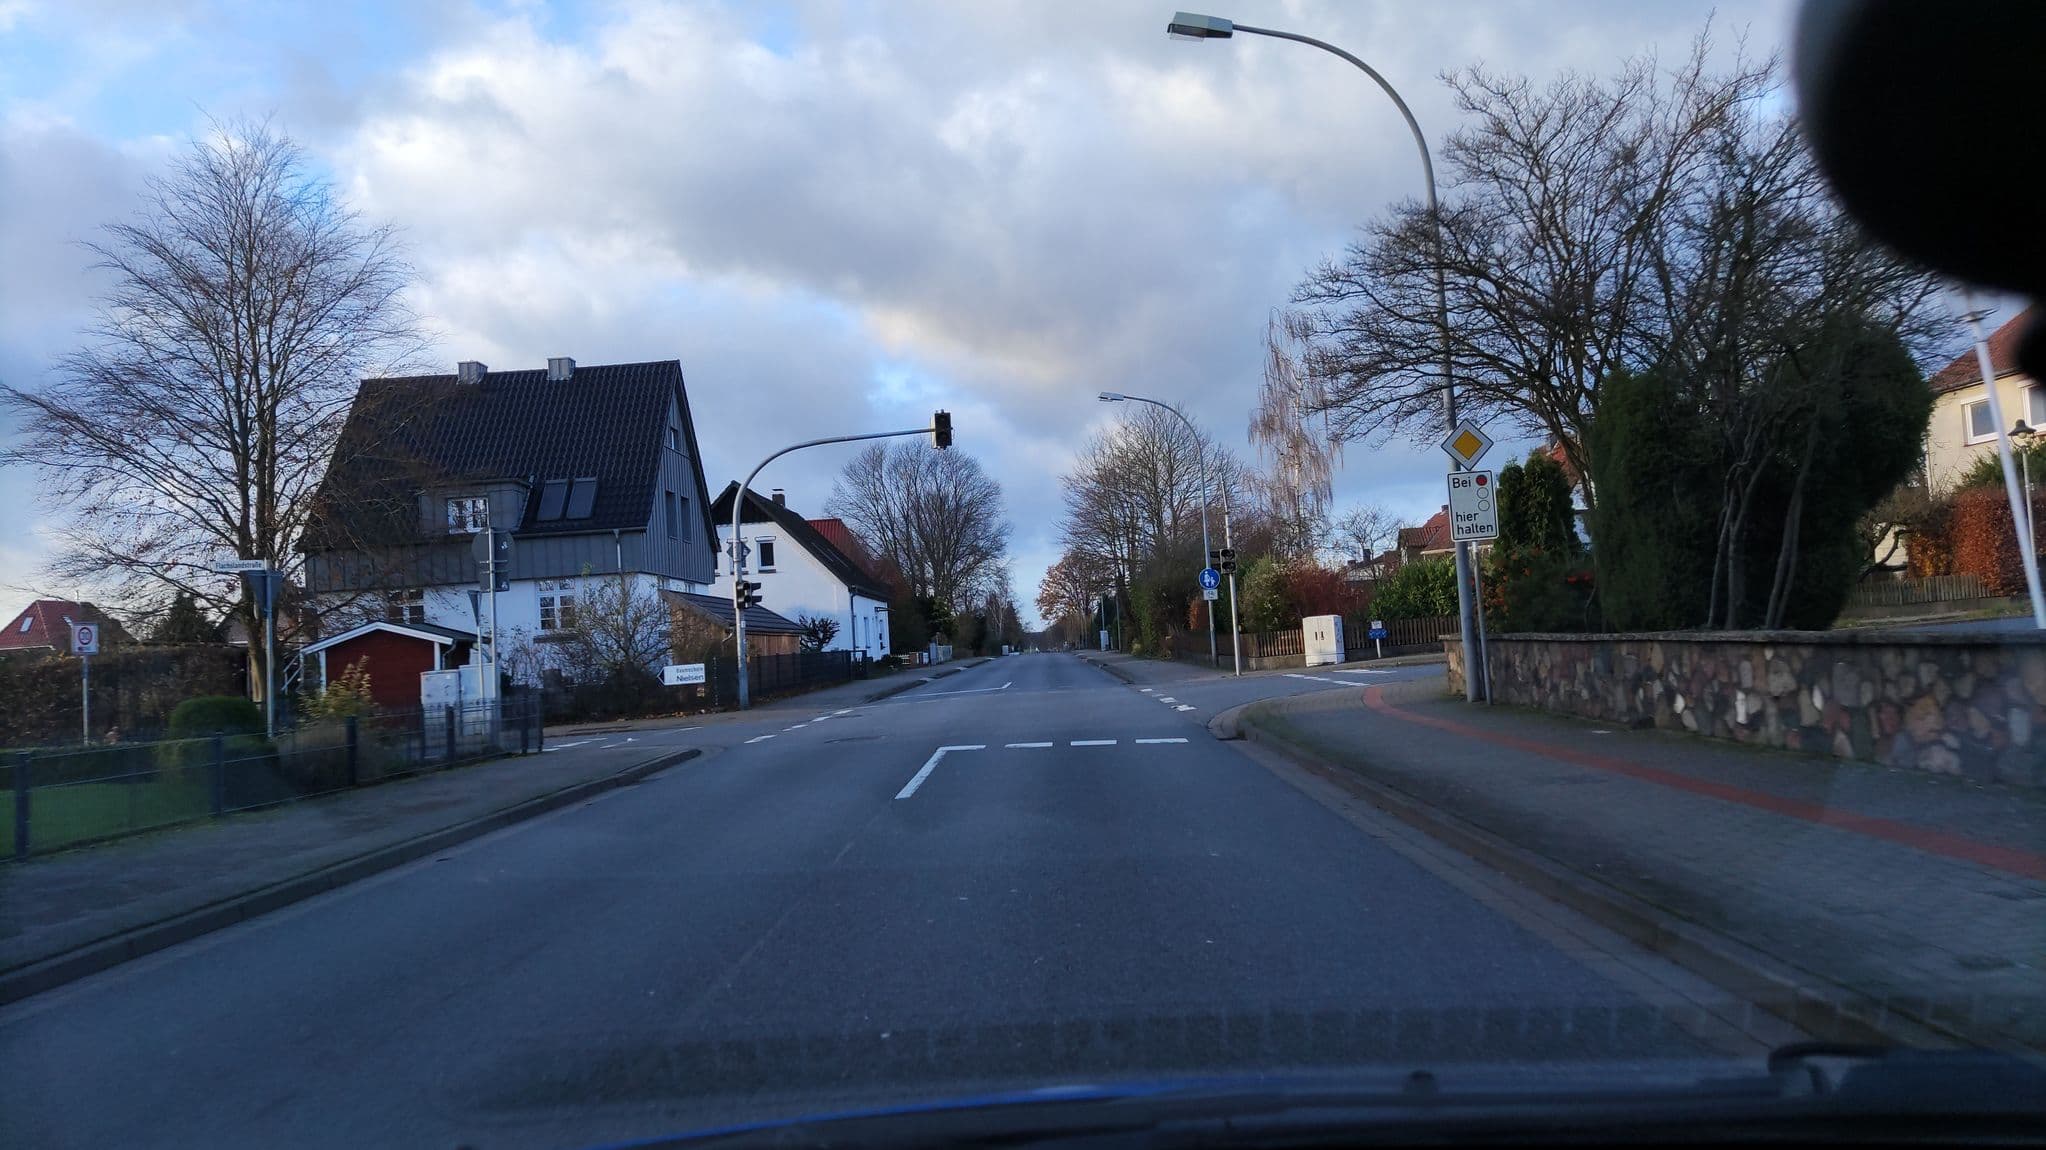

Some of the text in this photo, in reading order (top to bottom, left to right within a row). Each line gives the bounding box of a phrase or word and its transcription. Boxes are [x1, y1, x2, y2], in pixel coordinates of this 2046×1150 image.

[1452, 477, 1471, 488] Bei
[1456, 512, 1479, 522] hier
[1457, 523, 1494, 535] halten
